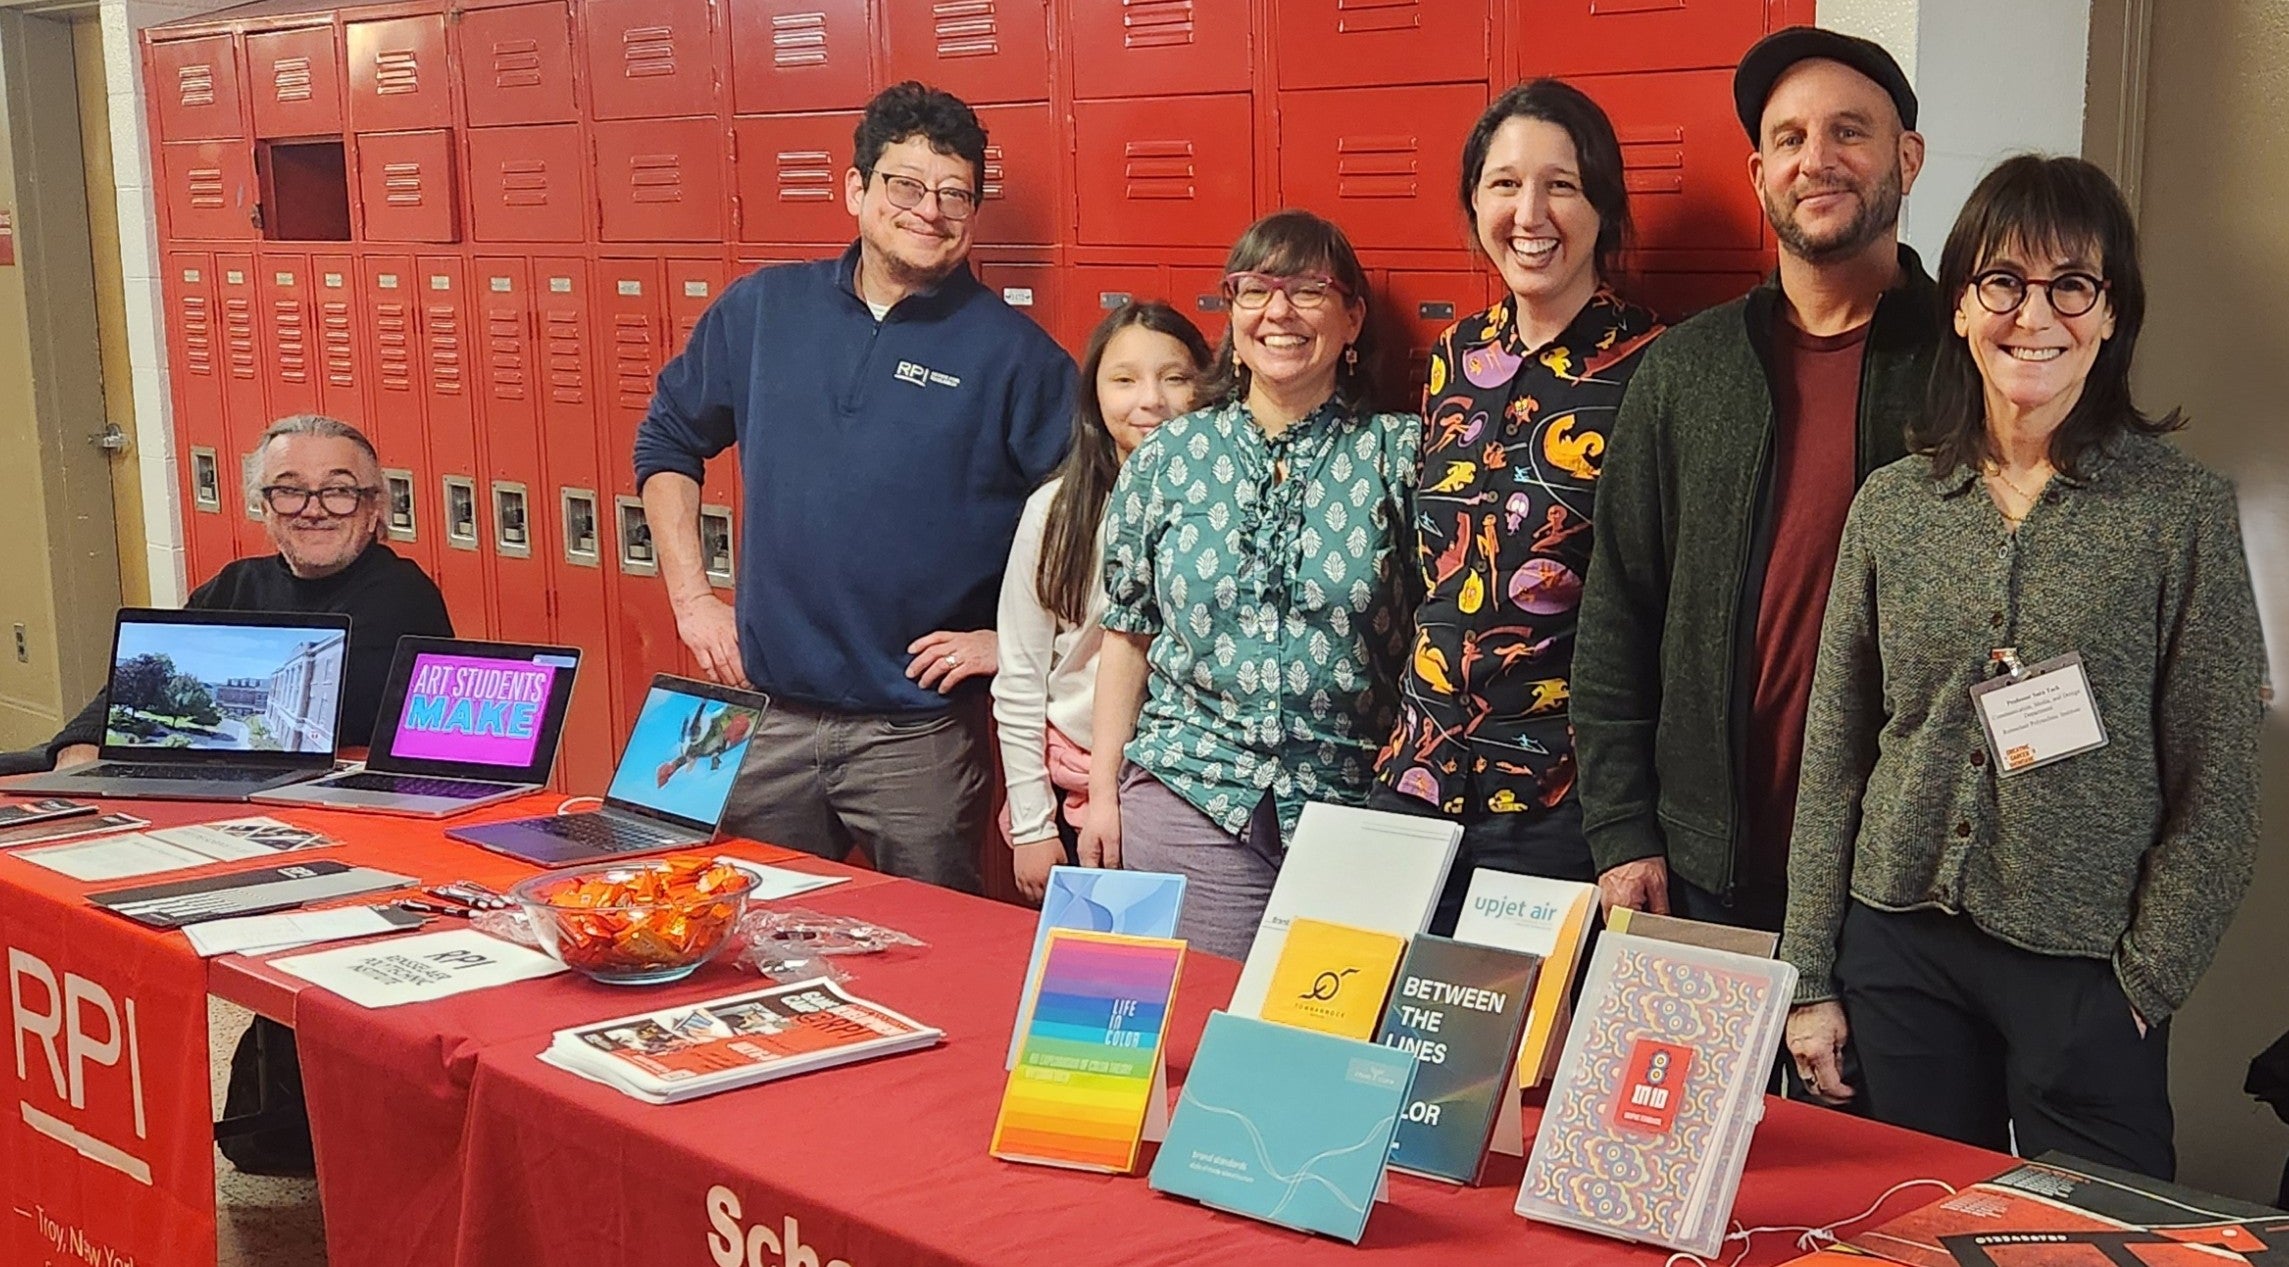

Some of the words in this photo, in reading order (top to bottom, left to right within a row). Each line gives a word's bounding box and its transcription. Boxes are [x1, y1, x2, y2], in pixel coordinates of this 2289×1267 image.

[896, 360, 929, 383] RPI
[413, 664, 453, 695] ART
[452, 667, 547, 702] STUDENTS
[404, 694, 538, 739] MAKE
[1475, 895, 1527, 918] upjet
[1530, 902, 1557, 920] air
[424, 949, 497, 970] RPI
[1113, 999, 1138, 1017] LIFE
[1403, 976, 1507, 1014] BETWEEN
[1401, 1006, 1444, 1033] THE
[9, 946, 146, 1140] RPI
[1105, 1030, 1141, 1048] COLOR
[1386, 1033, 1448, 1064] LINES
[35, 1204, 67, 1253] Troy,
[69, 1225, 101, 1267] New
[706, 1185, 853, 1267] Sch
